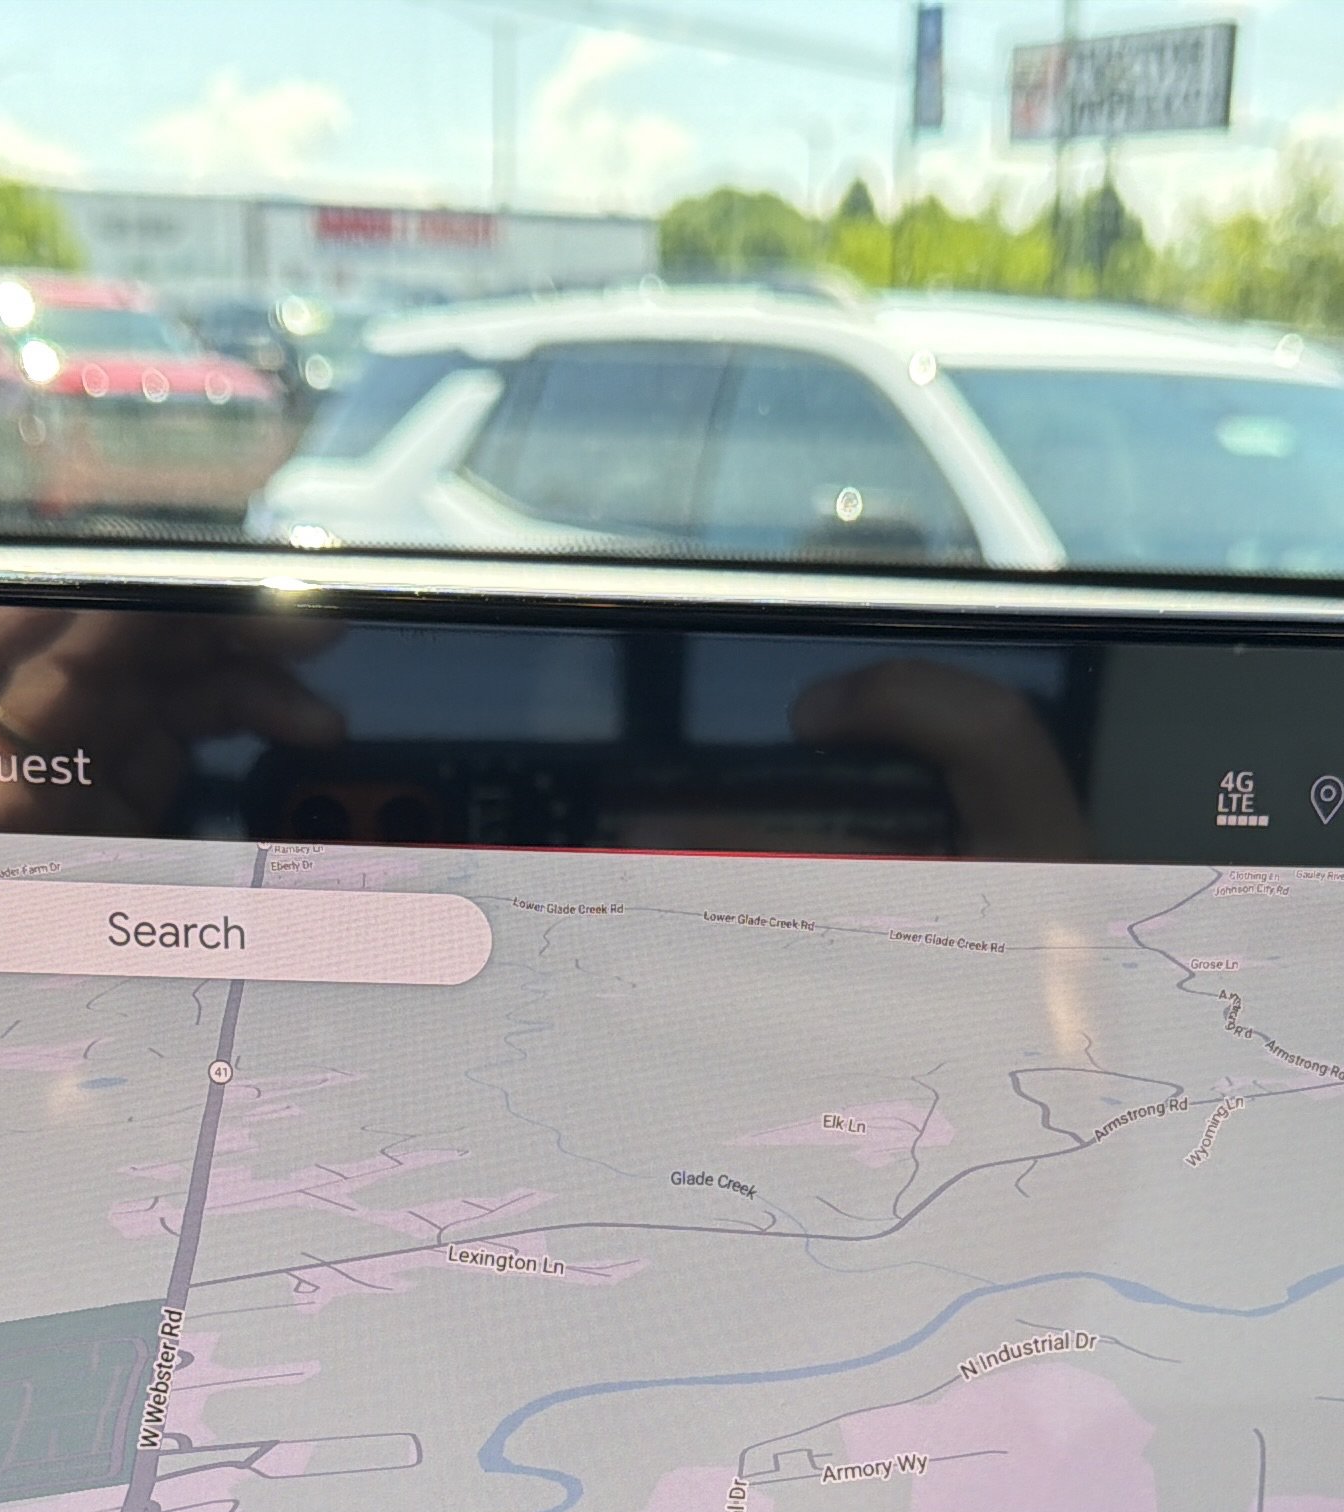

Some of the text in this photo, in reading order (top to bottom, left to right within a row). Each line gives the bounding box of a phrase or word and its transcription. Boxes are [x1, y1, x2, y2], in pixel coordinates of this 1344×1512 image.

[1220, 771, 1254, 793] 4G
[1217, 794, 1254, 813] LTE
[513, 899, 624, 914] Lower Glade Creek Rd
[108, 911, 245, 949] Search
[703, 910, 816, 931] Lower Glade Creek Rd
[889, 930, 1005, 953] Lower Glade Creek Rd
[1191, 959, 1239, 970] Grose Ln
[1265, 1040, 1328, 1076] Armstrong
[214, 1066, 228, 1079] 41
[823, 1114, 866, 1134] Elk Ln
[1094, 1097, 1189, 1142] Armstrong Rd
[1185, 1096, 1245, 1167] Wyoming Ln
[670, 1171, 758, 1200] Glade Creek
[448, 1245, 565, 1275] Lexington Ln
[959, 1332, 1097, 1380] N Industrial Dr
[140, 1309, 183, 1448] W Webster Rd
[821, 1454, 928, 1483] Armory Wy
[729, 1479, 748, 1500] Dr
